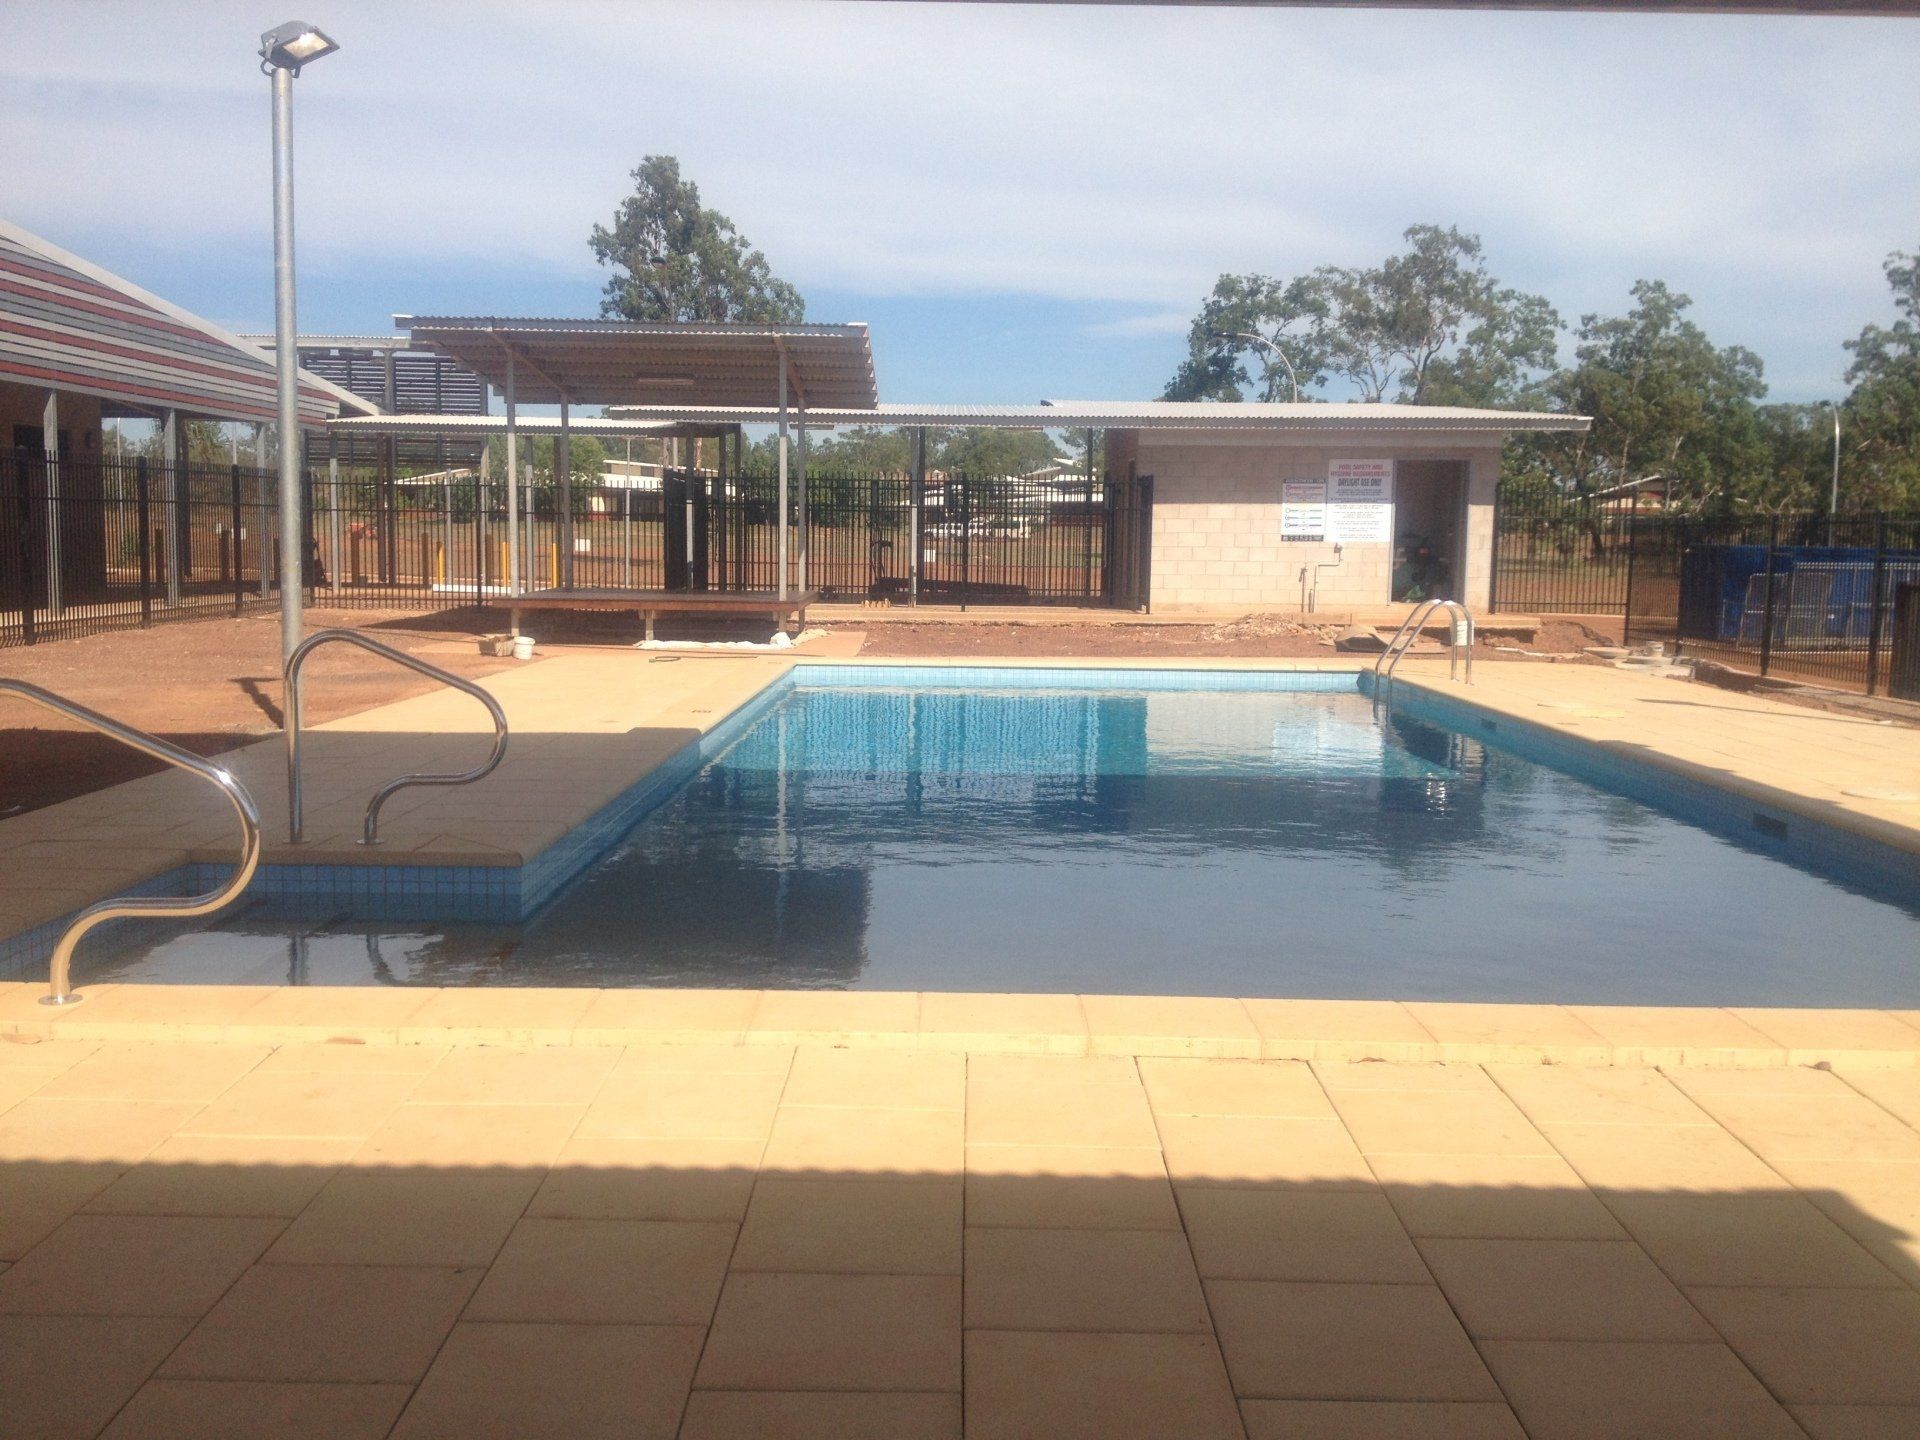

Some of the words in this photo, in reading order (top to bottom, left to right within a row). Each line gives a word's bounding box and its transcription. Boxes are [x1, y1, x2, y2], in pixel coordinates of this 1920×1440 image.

[1338, 478, 1360, 487] DAYLIGHT
[1360, 478, 1370, 487] USE
[1370, 478, 1382, 487] ONLY
